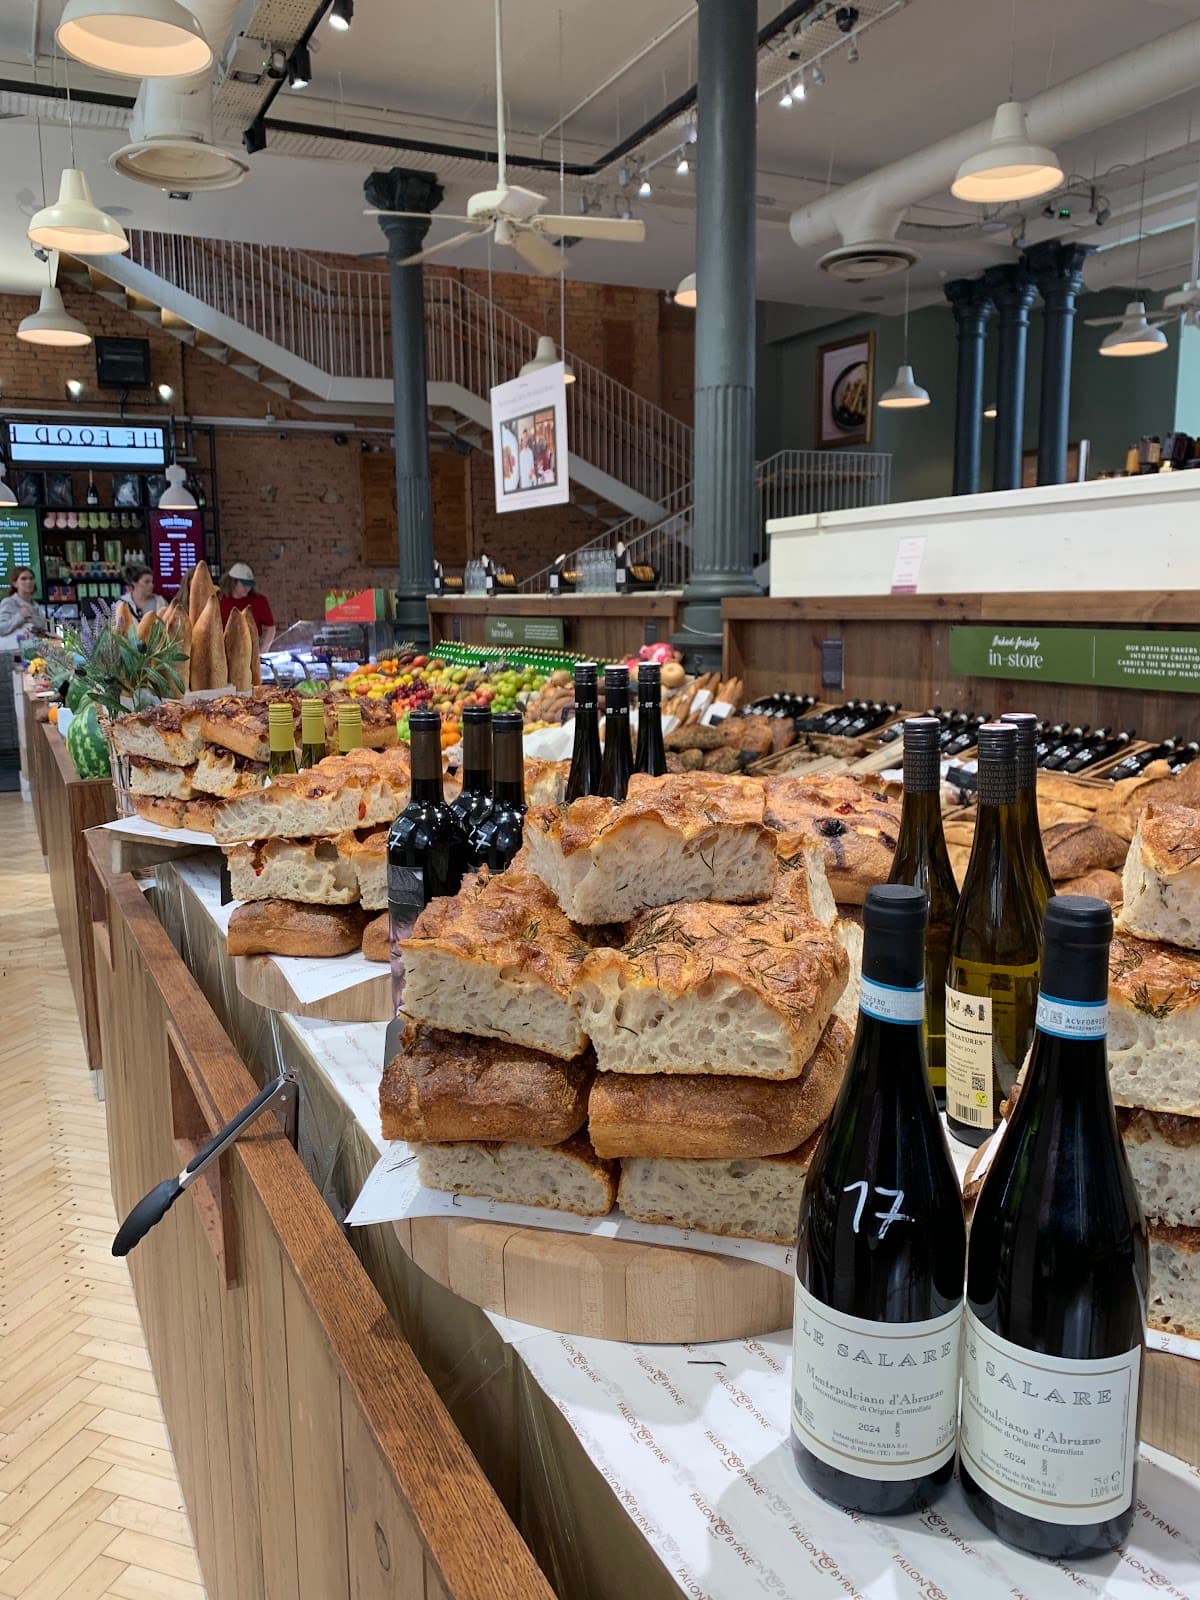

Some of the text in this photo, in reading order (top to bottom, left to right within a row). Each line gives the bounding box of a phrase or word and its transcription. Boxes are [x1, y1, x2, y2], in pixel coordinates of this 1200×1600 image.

[989, 648, 1043, 669] in-store
[1125, 644, 1198, 655] OUR ARTISAN BAKERS
[1130, 652, 1146, 660] INTO
[1148, 653, 1168, 661] EVERY
[1118, 659, 1144, 667] CARRIES
[1146, 661, 1158, 669] THE
[1160, 661, 1191, 671] WARMTH
[1138, 668, 1166, 677] ESSENCE
[843, 1180, 906, 1240] 17
[802, 1318, 951, 1367] LE SALARE
[559, 1335, 576, 1355] FALLON
[580, 1365, 601, 1383] BYRNE
[758, 1351, 782, 1373] BYRNE
[661, 1381, 685, 1406] BYRNE
[806, 1362, 944, 1406] Montepulciano d'Abruzzo
[985, 1361, 1112, 1406] SALARE
[714, 1371, 740, 1397] FALLON
[745, 1404, 771, 1429] BYRNE
[617, 1402, 640, 1429] FALLON
[646, 1440, 670, 1464] BYRNE
[857, 1422, 881, 1433] 2024
[1034, 1428, 1101, 1446] d'Abruzzo
[704, 1430, 730, 1456] FALLON
[737, 1468, 765, 1496] BYRNE
[1003, 1449, 1026, 1465] 2024
[630, 1507, 656, 1536] BYRNE
[690, 1492, 718, 1523] FALLON
[725, 1535, 753, 1566] BYRNE
[1143, 1510, 1181, 1540] BYRNE
[940, 1527, 975, 1555] BYRNE
[788, 1524, 819, 1557] FALLON
[830, 1570, 864, 1600] BYRNE
[892, 1554, 928, 1587] FALLON
[676, 1568, 706, 1600] FALLON
